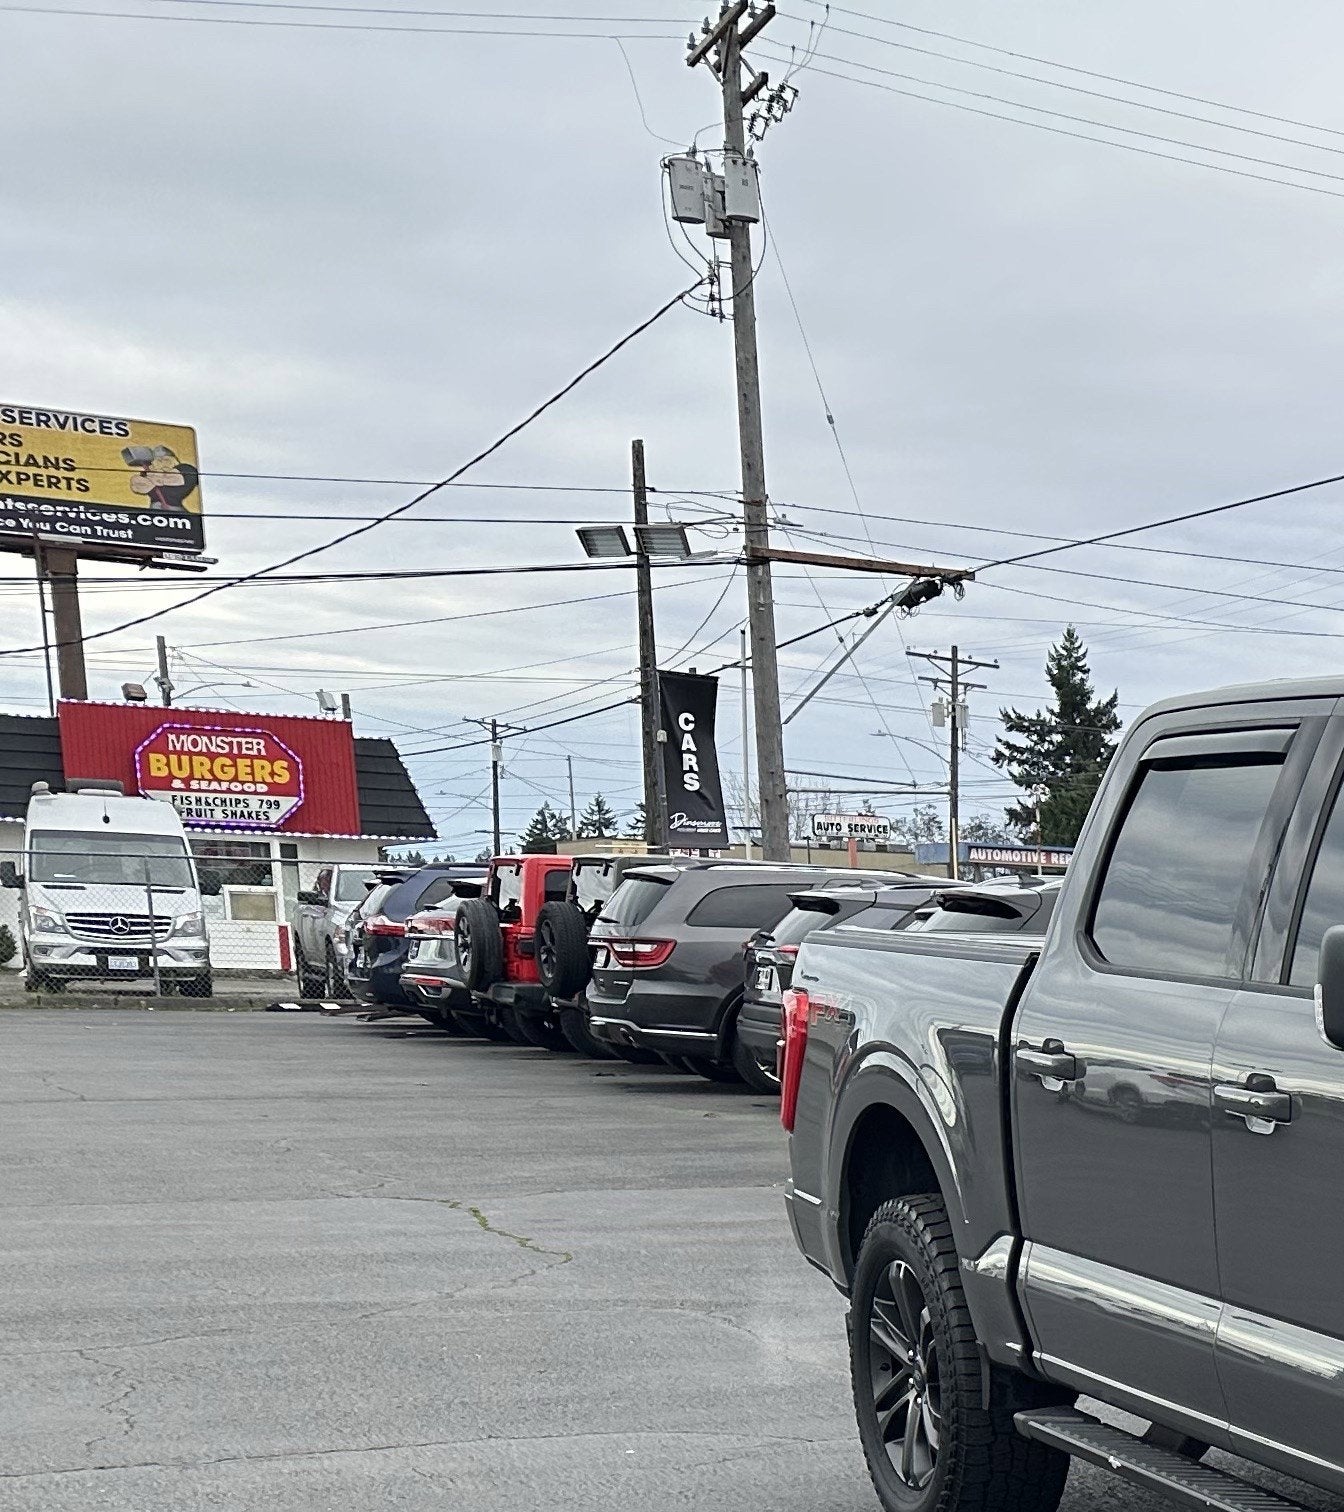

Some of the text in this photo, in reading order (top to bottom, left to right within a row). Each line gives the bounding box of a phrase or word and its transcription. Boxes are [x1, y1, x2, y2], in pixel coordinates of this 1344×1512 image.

[1, 408, 130, 438] SERVICES
[19, 517, 51, 531] You
[55, 521, 92, 535] Can
[96, 525, 134, 539] Trust
[166, 733, 267, 756] MONSTER
[678, 712, 701, 792] CARS
[148, 752, 291, 784] BURGERS
[171, 779, 269, 793] & SEAFOOD
[258, 799, 281, 810] 799
[223, 808, 270, 821] SHAKES
[816, 822, 889, 835] AUTO SERVICE
[969, 848, 1047, 864] AUTOMOTIVE
